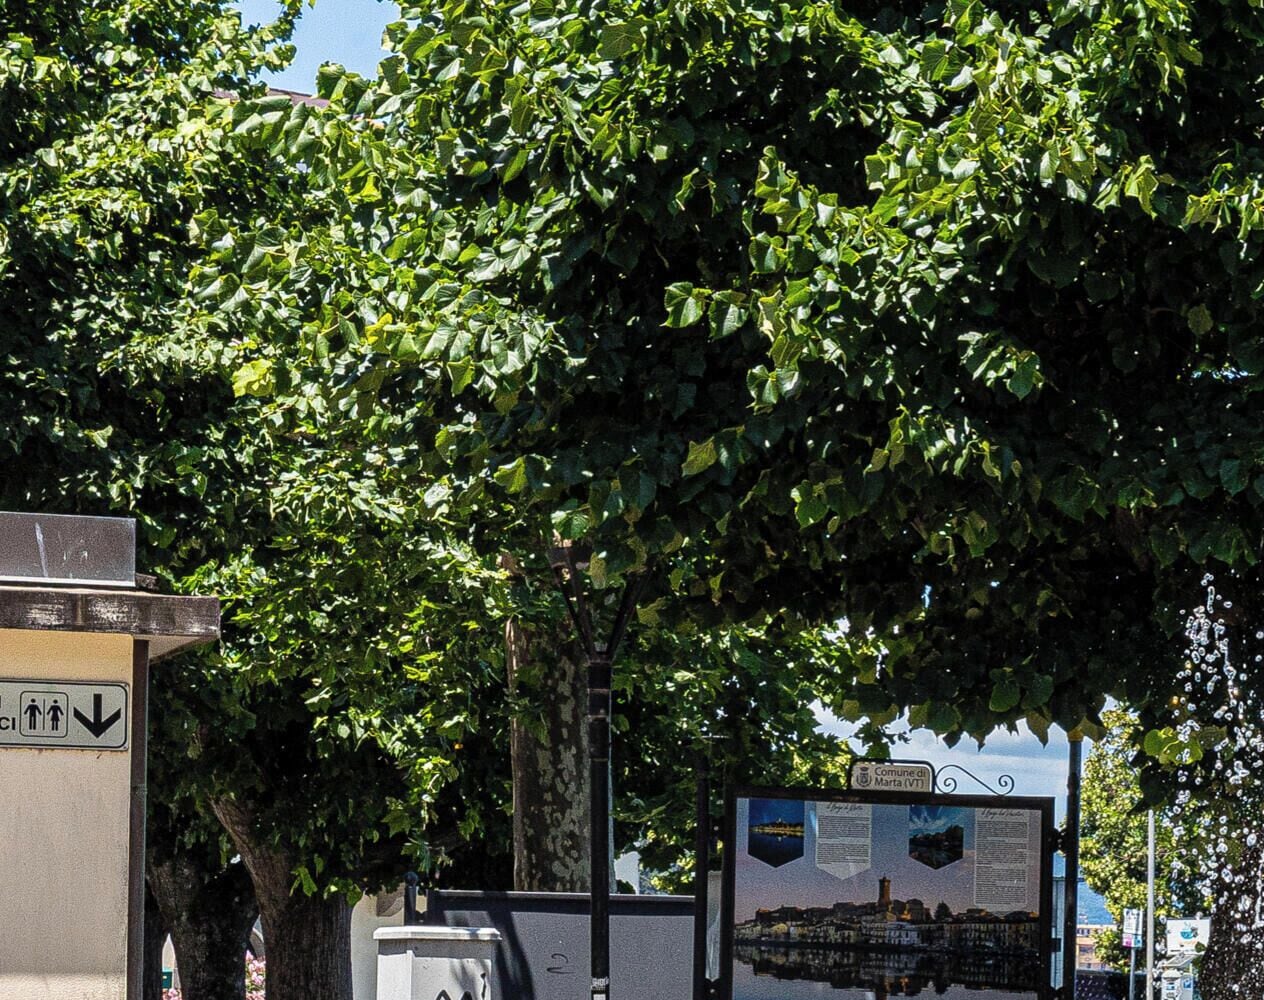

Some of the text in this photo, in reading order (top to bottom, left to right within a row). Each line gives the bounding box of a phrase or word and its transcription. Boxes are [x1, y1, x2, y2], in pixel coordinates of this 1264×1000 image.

[875, 766, 926, 778] Comune di
[874, 777, 924, 789] Marta (VT)
